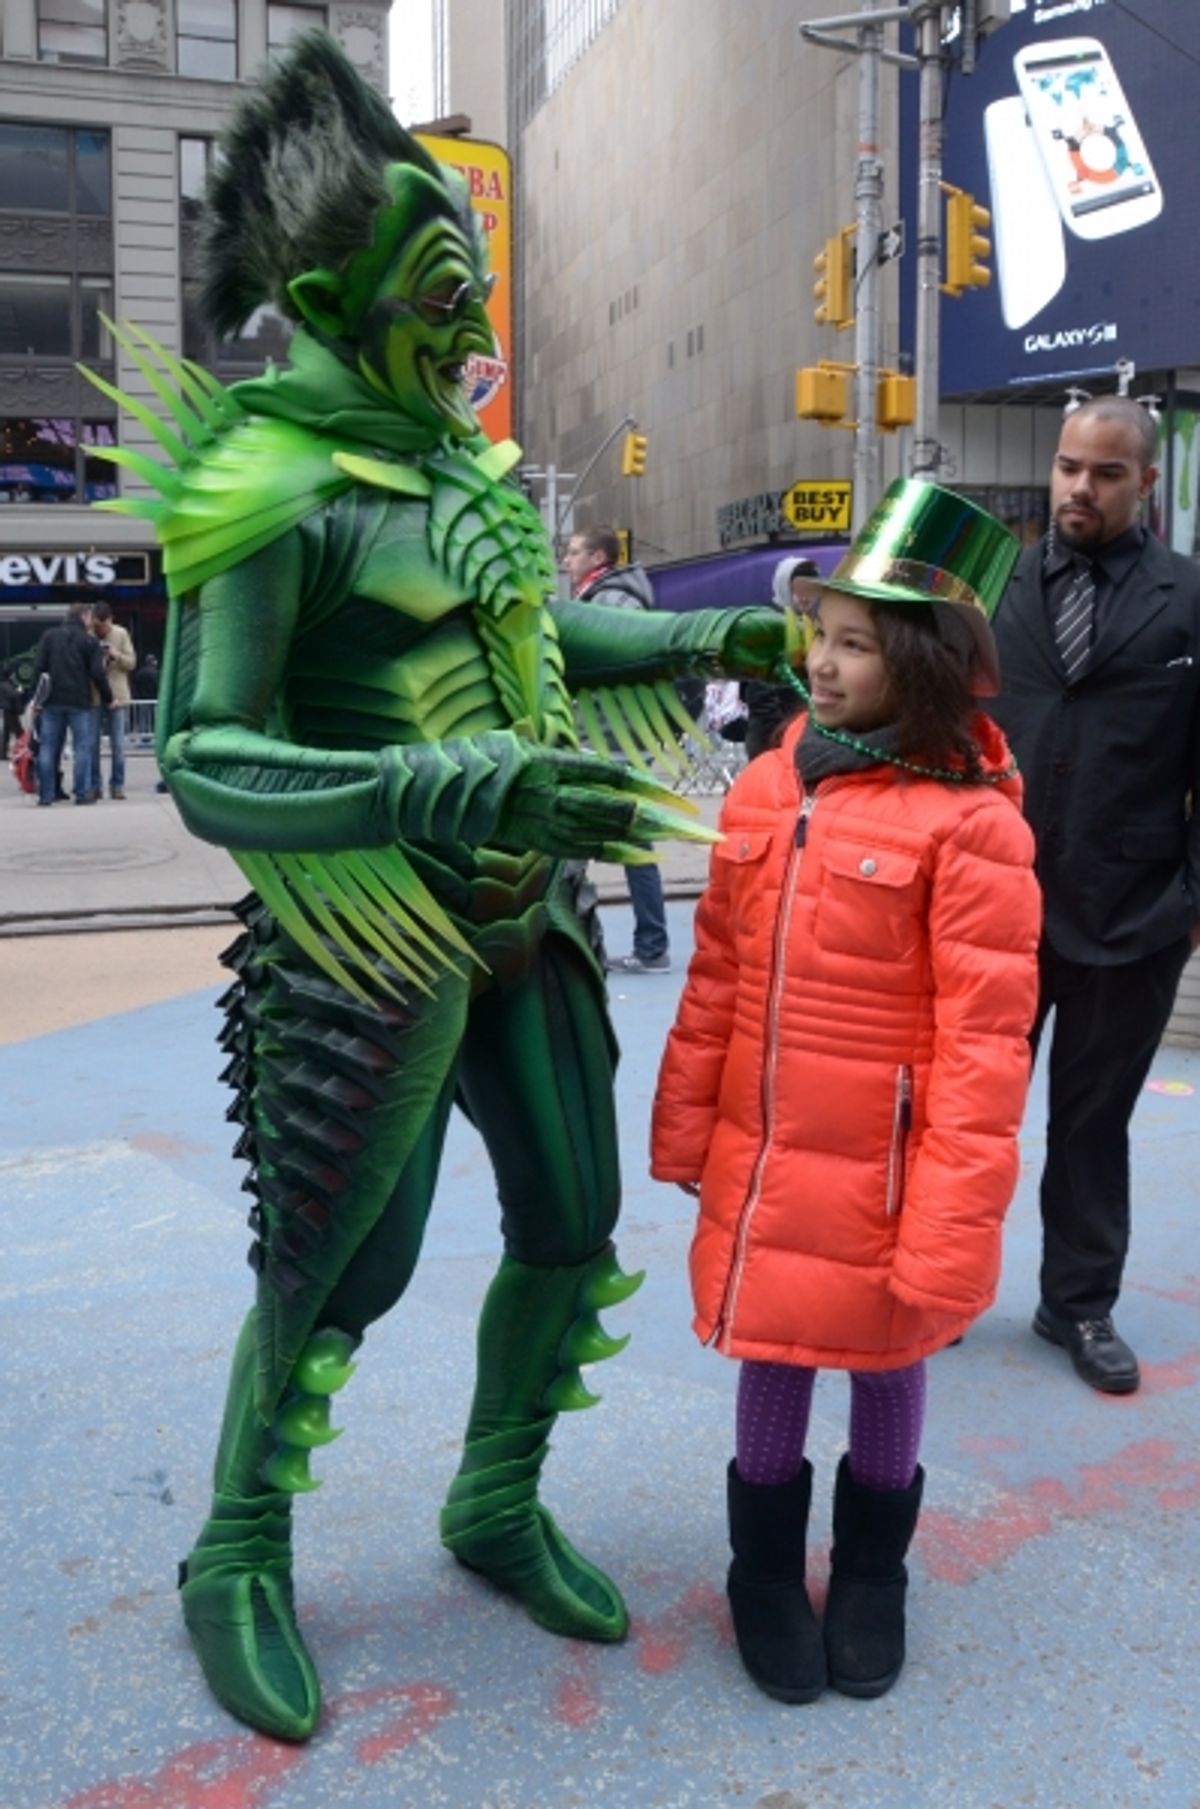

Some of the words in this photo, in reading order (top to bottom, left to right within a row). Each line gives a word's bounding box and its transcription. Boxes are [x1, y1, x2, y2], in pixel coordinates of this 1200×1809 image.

[1024, 328, 1084, 353] GALAXY
[792, 491, 850, 504] BEST
[795, 506, 842, 522] BUY
[0, 552, 117, 585] evi's
